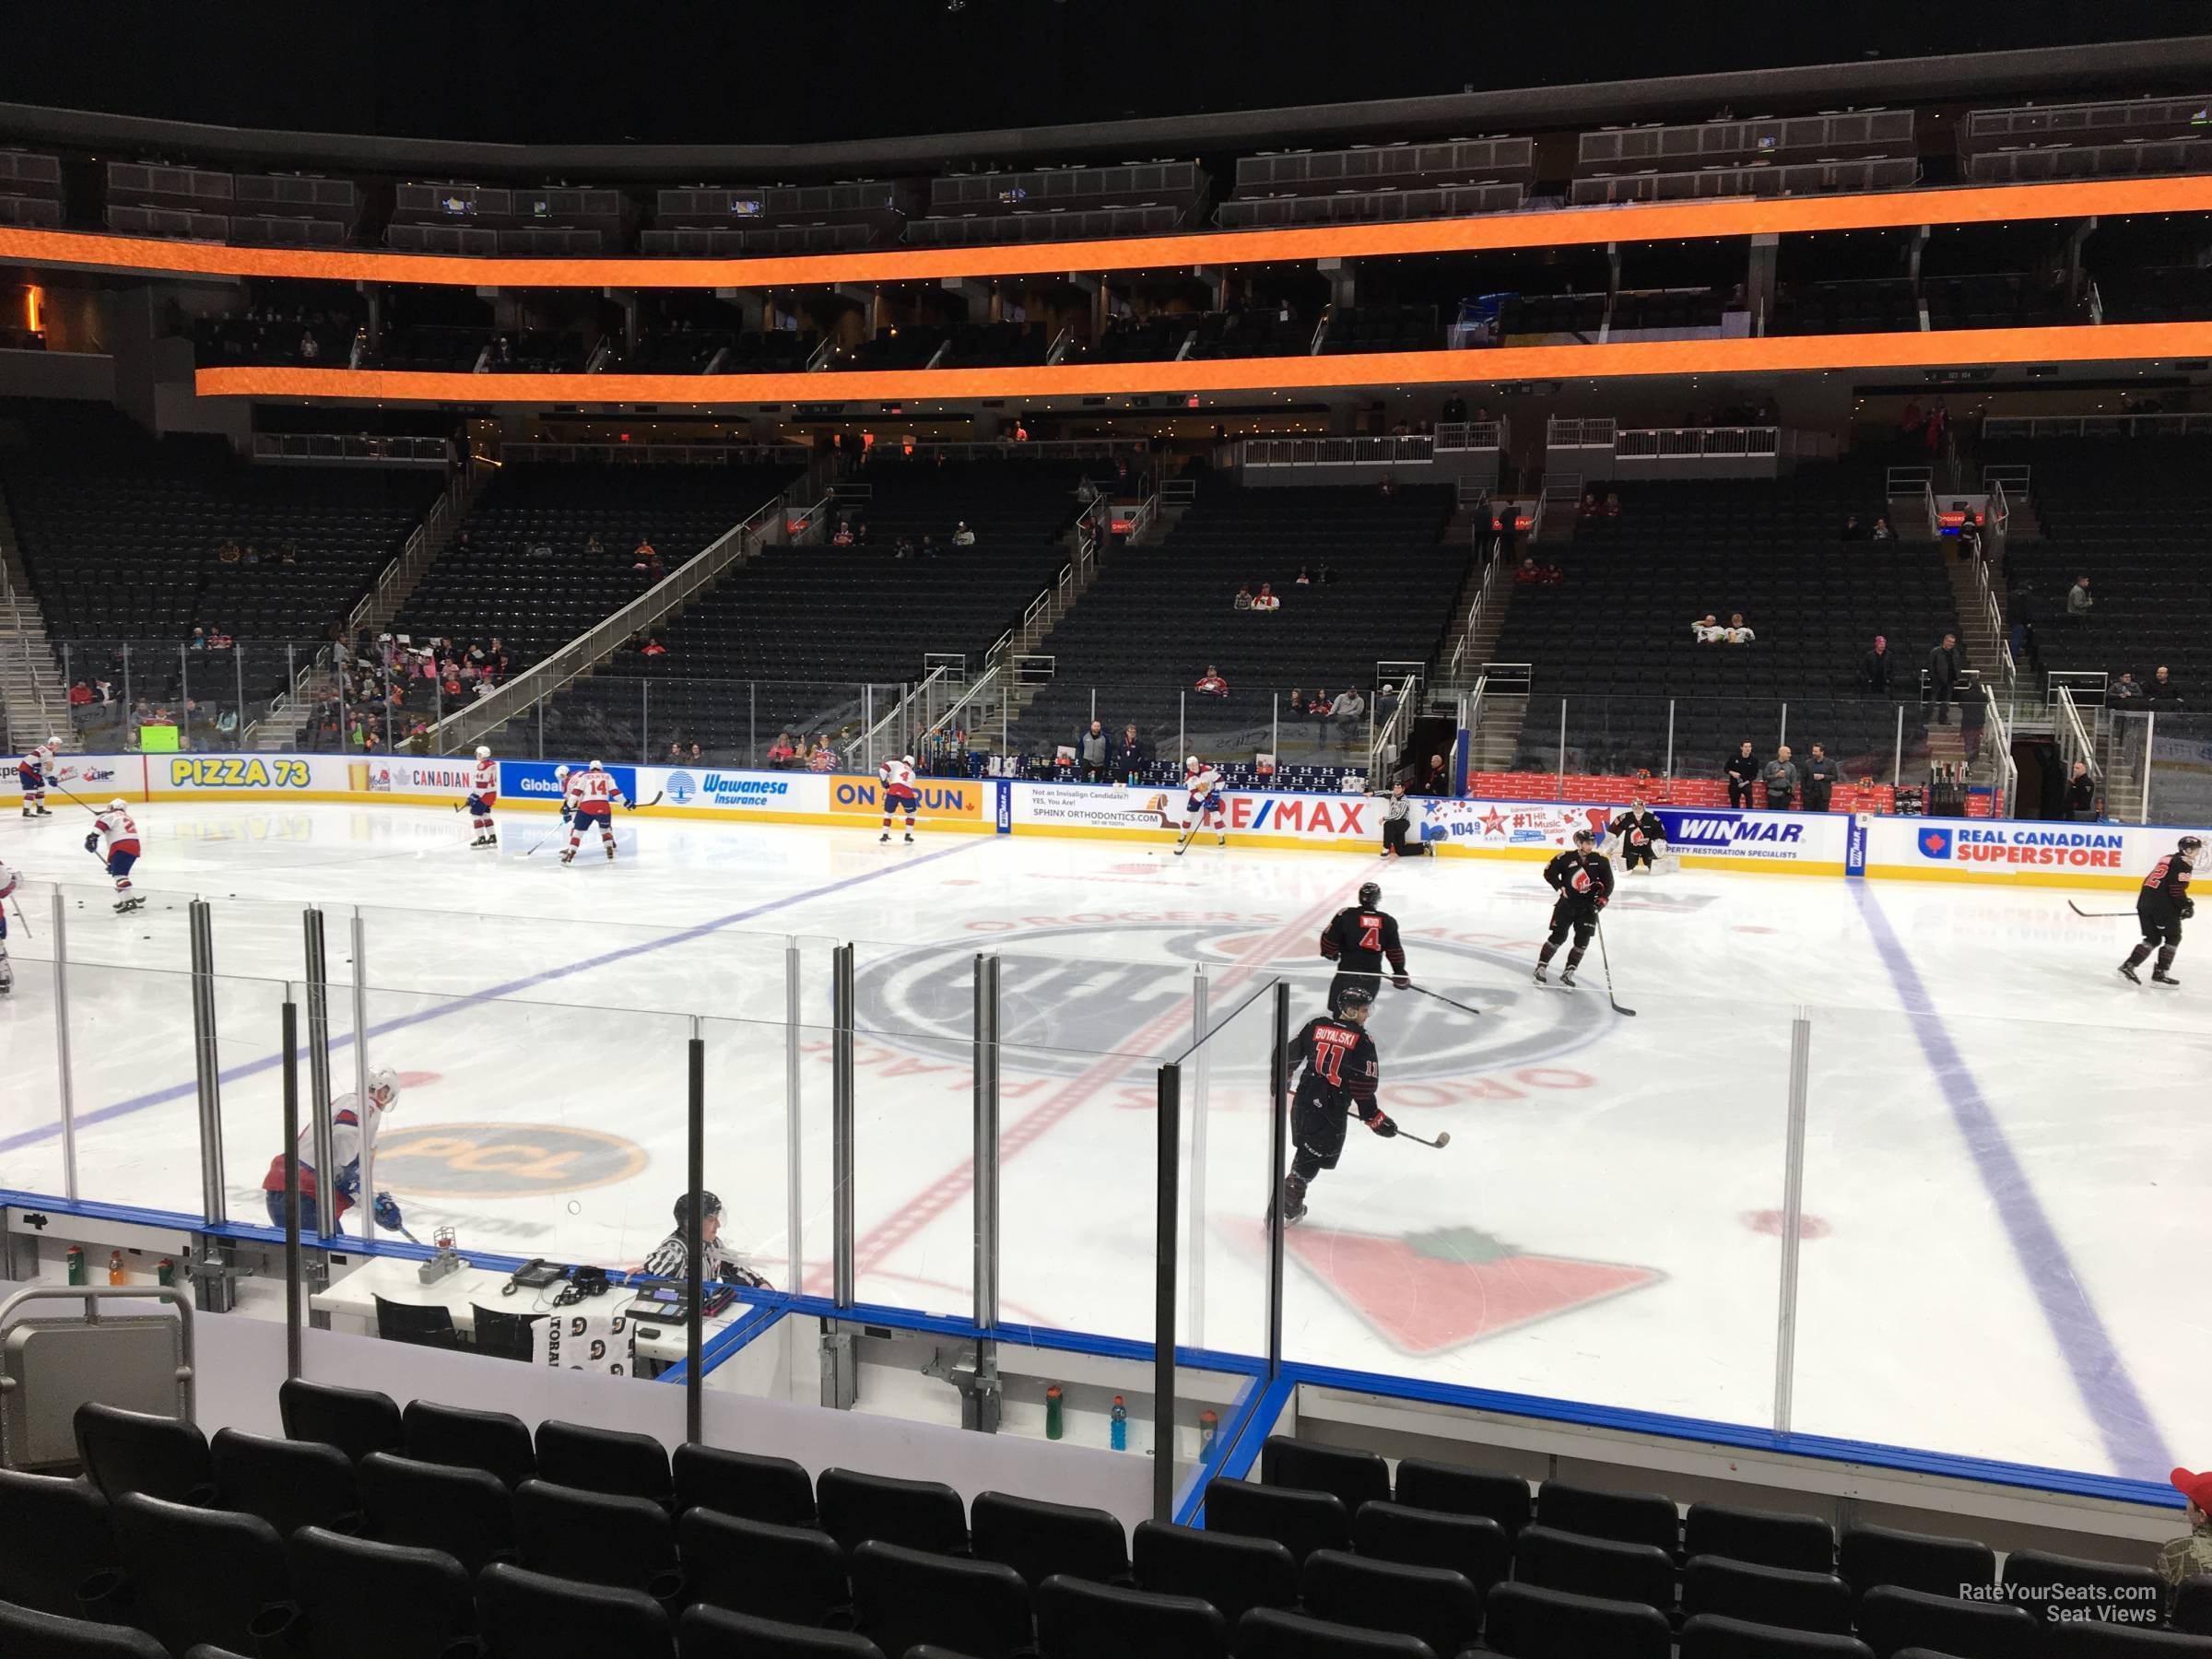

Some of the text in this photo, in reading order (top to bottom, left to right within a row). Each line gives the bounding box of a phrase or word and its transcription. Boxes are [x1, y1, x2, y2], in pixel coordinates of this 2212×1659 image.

[171, 759, 312, 787] PIZZA 73
[413, 771, 470, 788] CANADIAN
[900, 771, 910, 782] 4
[521, 778, 562, 792] Global
[590, 780, 606, 795] 14
[703, 774, 788, 794] Wawanesa
[714, 794, 768, 806] Insurance
[837, 784, 875, 806] ON
[1056, 790, 1088, 799] Invisalign
[1033, 808, 1159, 823] SPHINX ORTHODONTICS.COM
[1512, 814, 1532, 828] #1
[1535, 820, 1560, 829] Music
[1678, 818, 1804, 842] WINMAR
[1851, 830, 1861, 865] WINMAR
[1959, 830, 2123, 849] REAL CANADIAN
[1692, 847, 1746, 856] RESTORATION
[1747, 850, 1796, 858] SPECIALISTS
[1958, 844, 2121, 867] SUPERSTORE
[1359, 927, 1382, 951] 4
[1315, 1028, 1356, 1046] BUYALSKI
[1315, 1042, 1346, 1088] 11
[1366, 1061, 1379, 1077] 11
